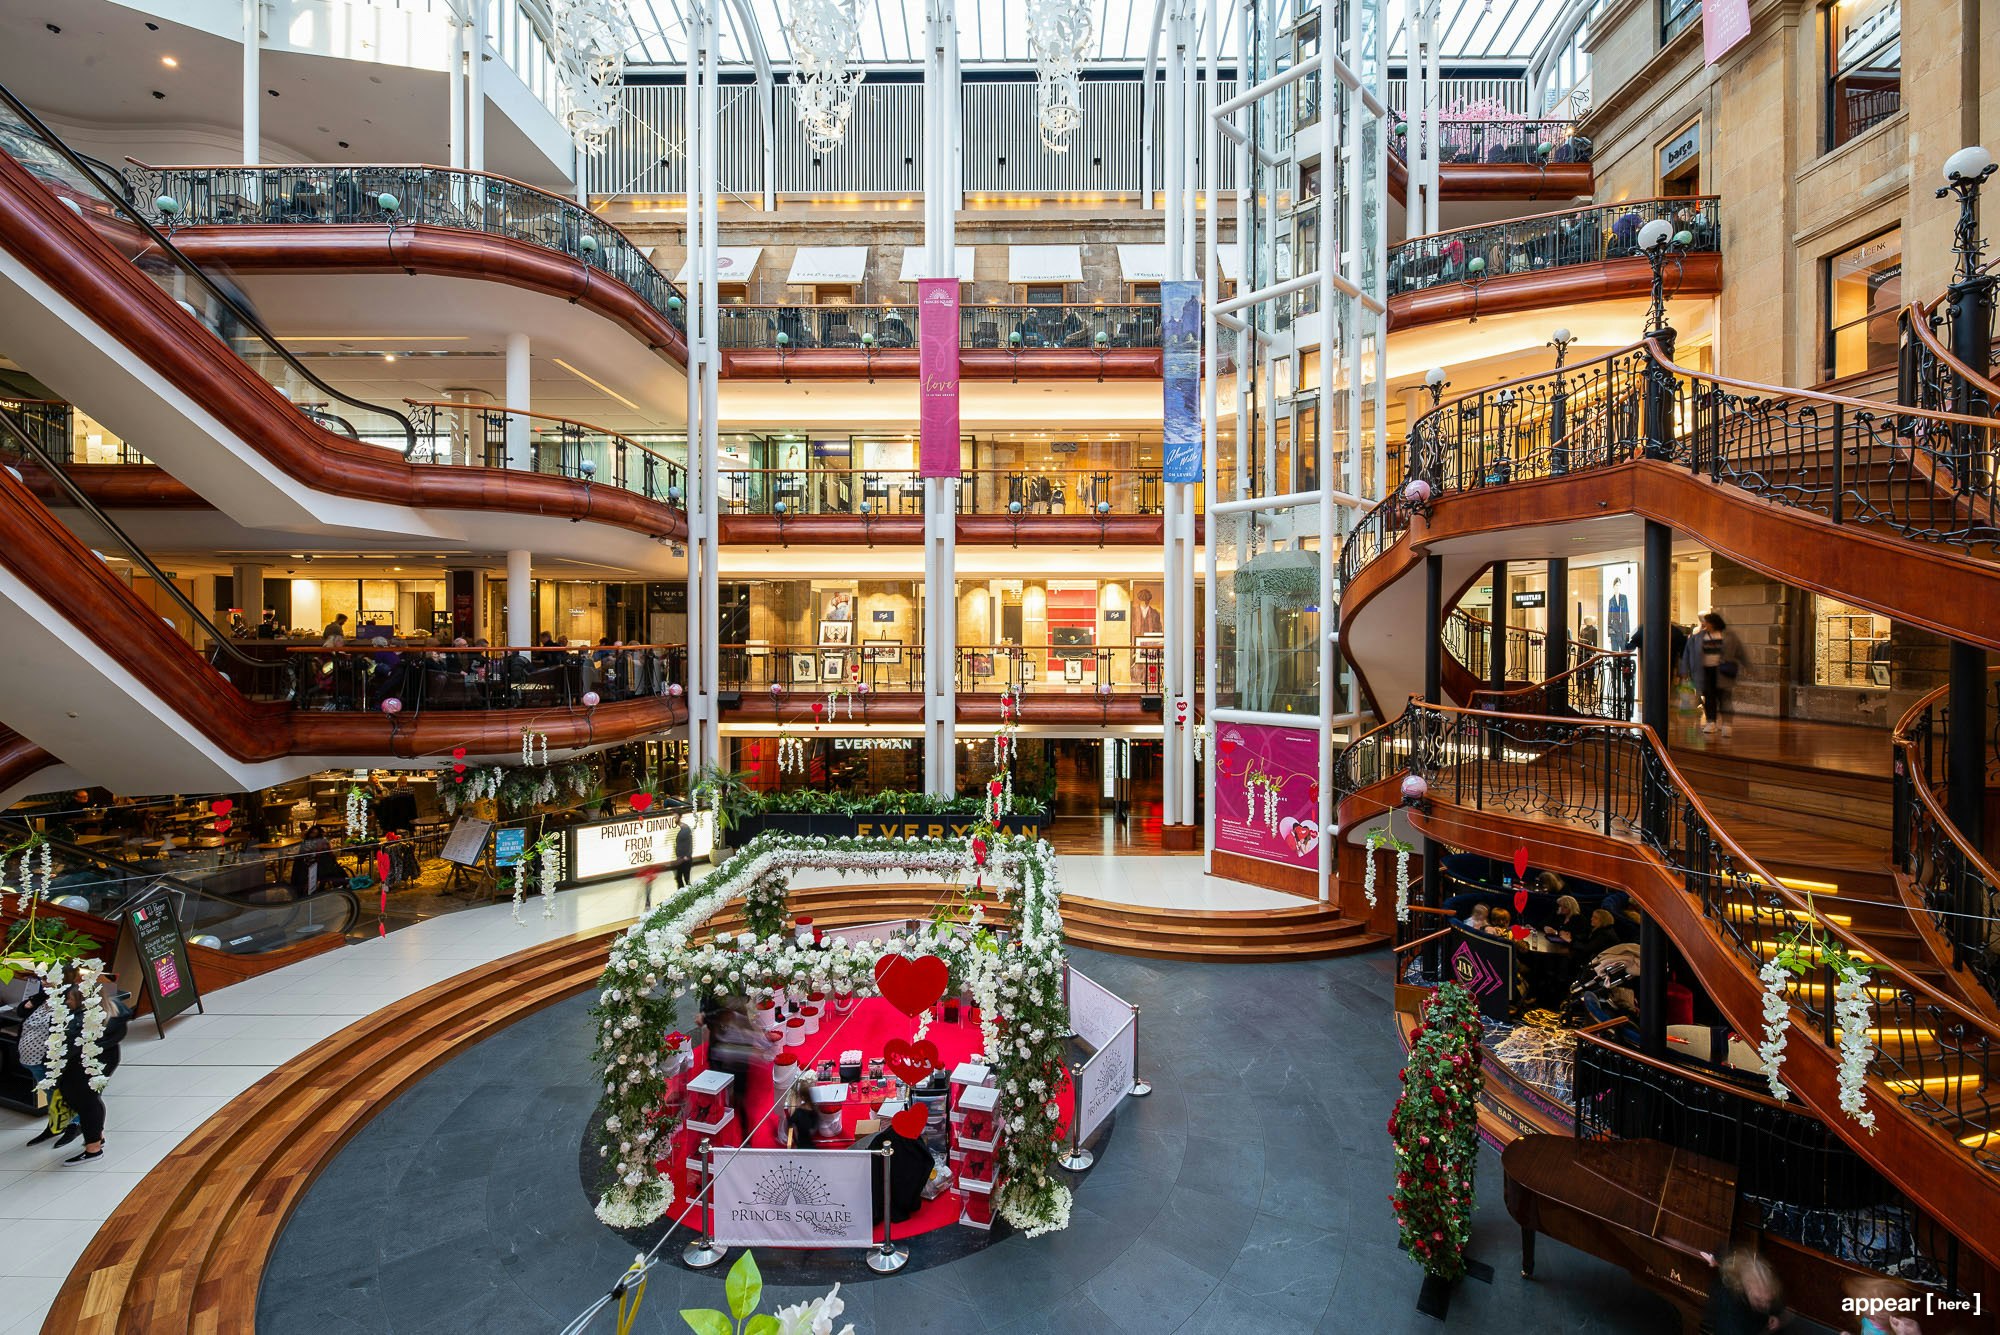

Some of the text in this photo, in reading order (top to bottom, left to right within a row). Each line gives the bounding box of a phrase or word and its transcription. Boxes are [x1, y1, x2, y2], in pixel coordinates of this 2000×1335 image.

[1875, 268, 1901, 282] HOURGLA
[922, 374, 957, 392] love
[834, 738, 912, 750] EVERYMAN
[601, 823, 640, 840] PRIVATE
[858, 823, 1038, 842] EVERYAN
[625, 836, 653, 851] FROM
[1497, 1106, 1513, 1123] BAR
[731, 1209, 852, 1226] PRINCES SQUARE
